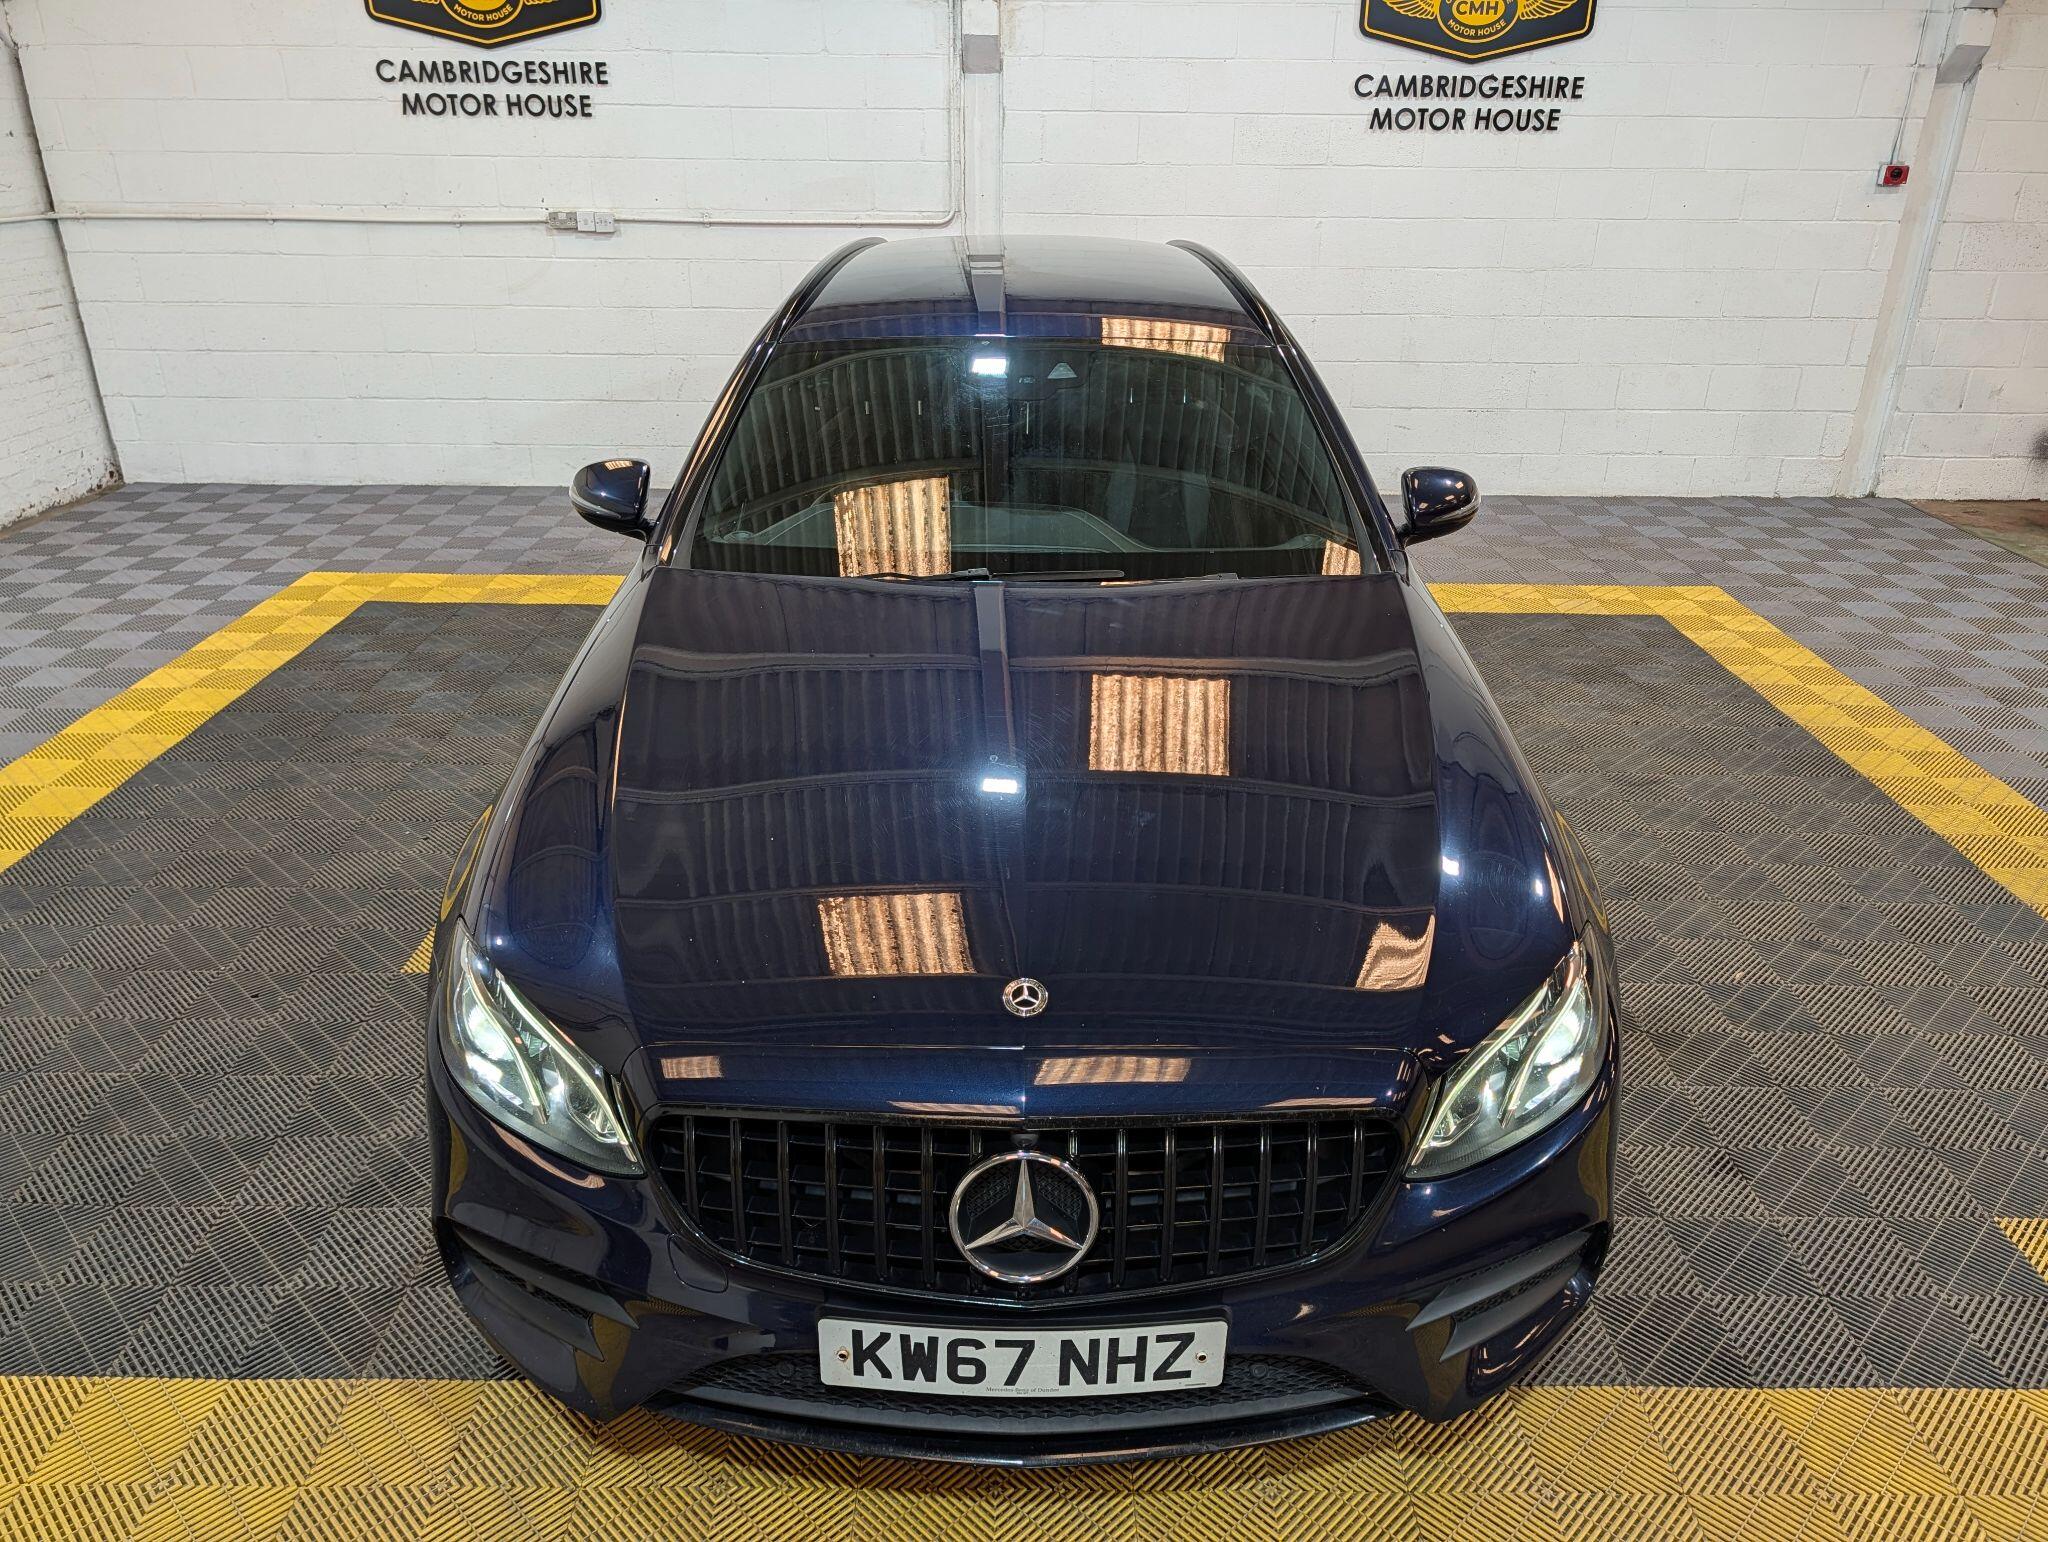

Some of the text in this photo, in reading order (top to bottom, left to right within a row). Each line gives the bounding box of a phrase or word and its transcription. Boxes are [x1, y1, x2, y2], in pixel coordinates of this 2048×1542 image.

[453, 3, 514, 22] MOTOR HOUSE
[1456, 0, 1499, 15] CMH
[1447, 18, 1507, 36] MOTOR HOUSE
[375, 59, 609, 85] CAMBRIDGESHIRE
[1353, 74, 1586, 99] CAMBRIDGESHIRE
[402, 92, 593, 117] MOTOR HOUSE
[1369, 107, 1562, 132] MOTOR HOUSE
[851, 1328, 1196, 1387] KW67 NHZ
